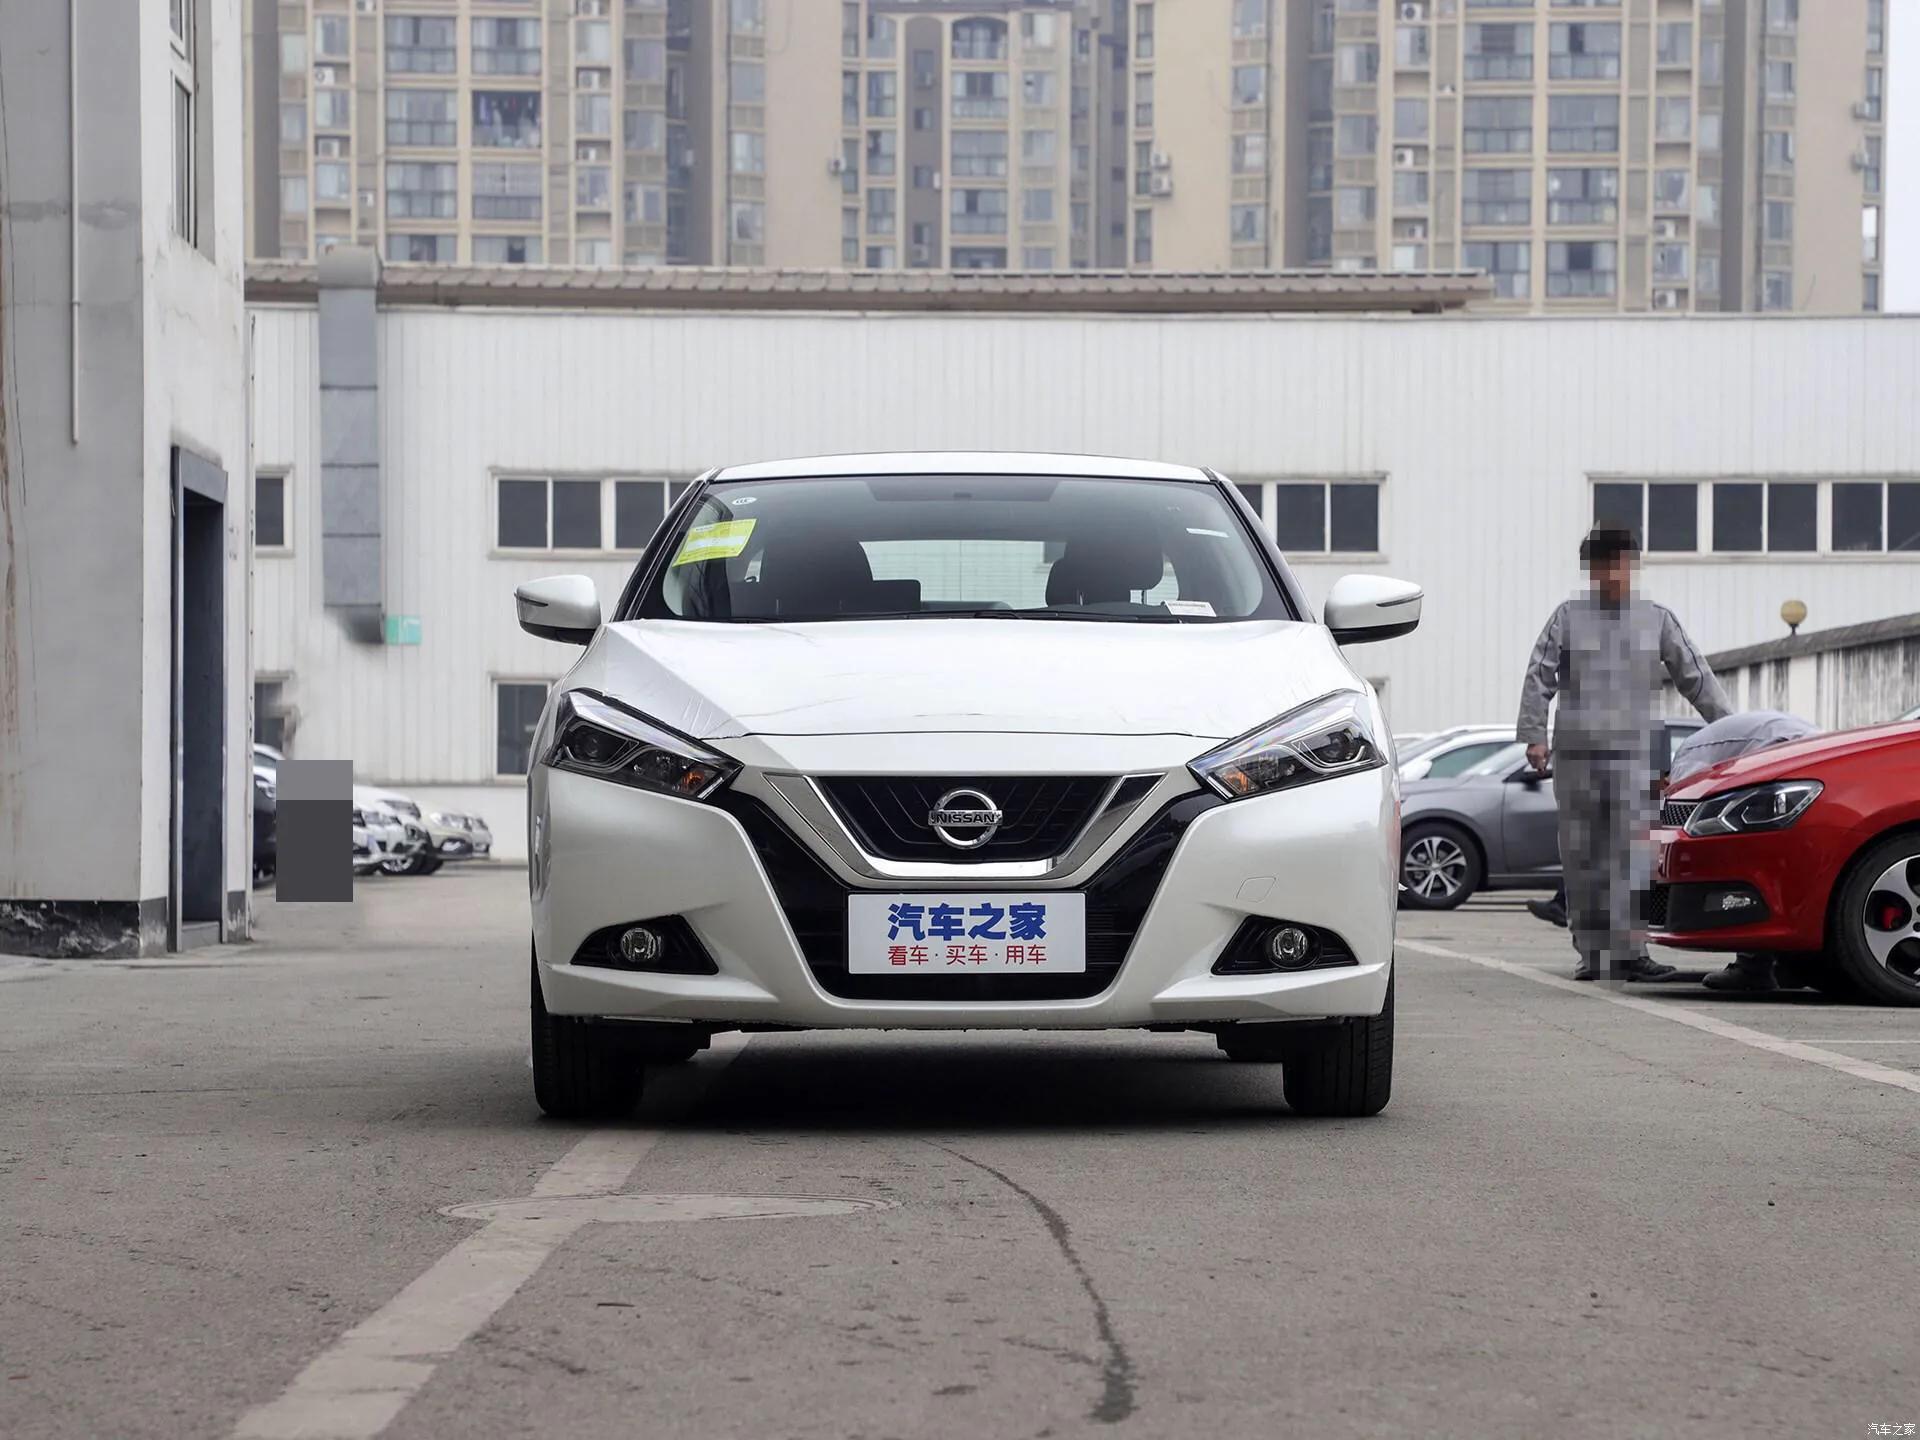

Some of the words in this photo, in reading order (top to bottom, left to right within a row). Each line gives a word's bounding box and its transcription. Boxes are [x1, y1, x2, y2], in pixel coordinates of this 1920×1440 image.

[936, 813, 995, 823] NISSAN
[887, 902, 1047, 941] 汽车之家
